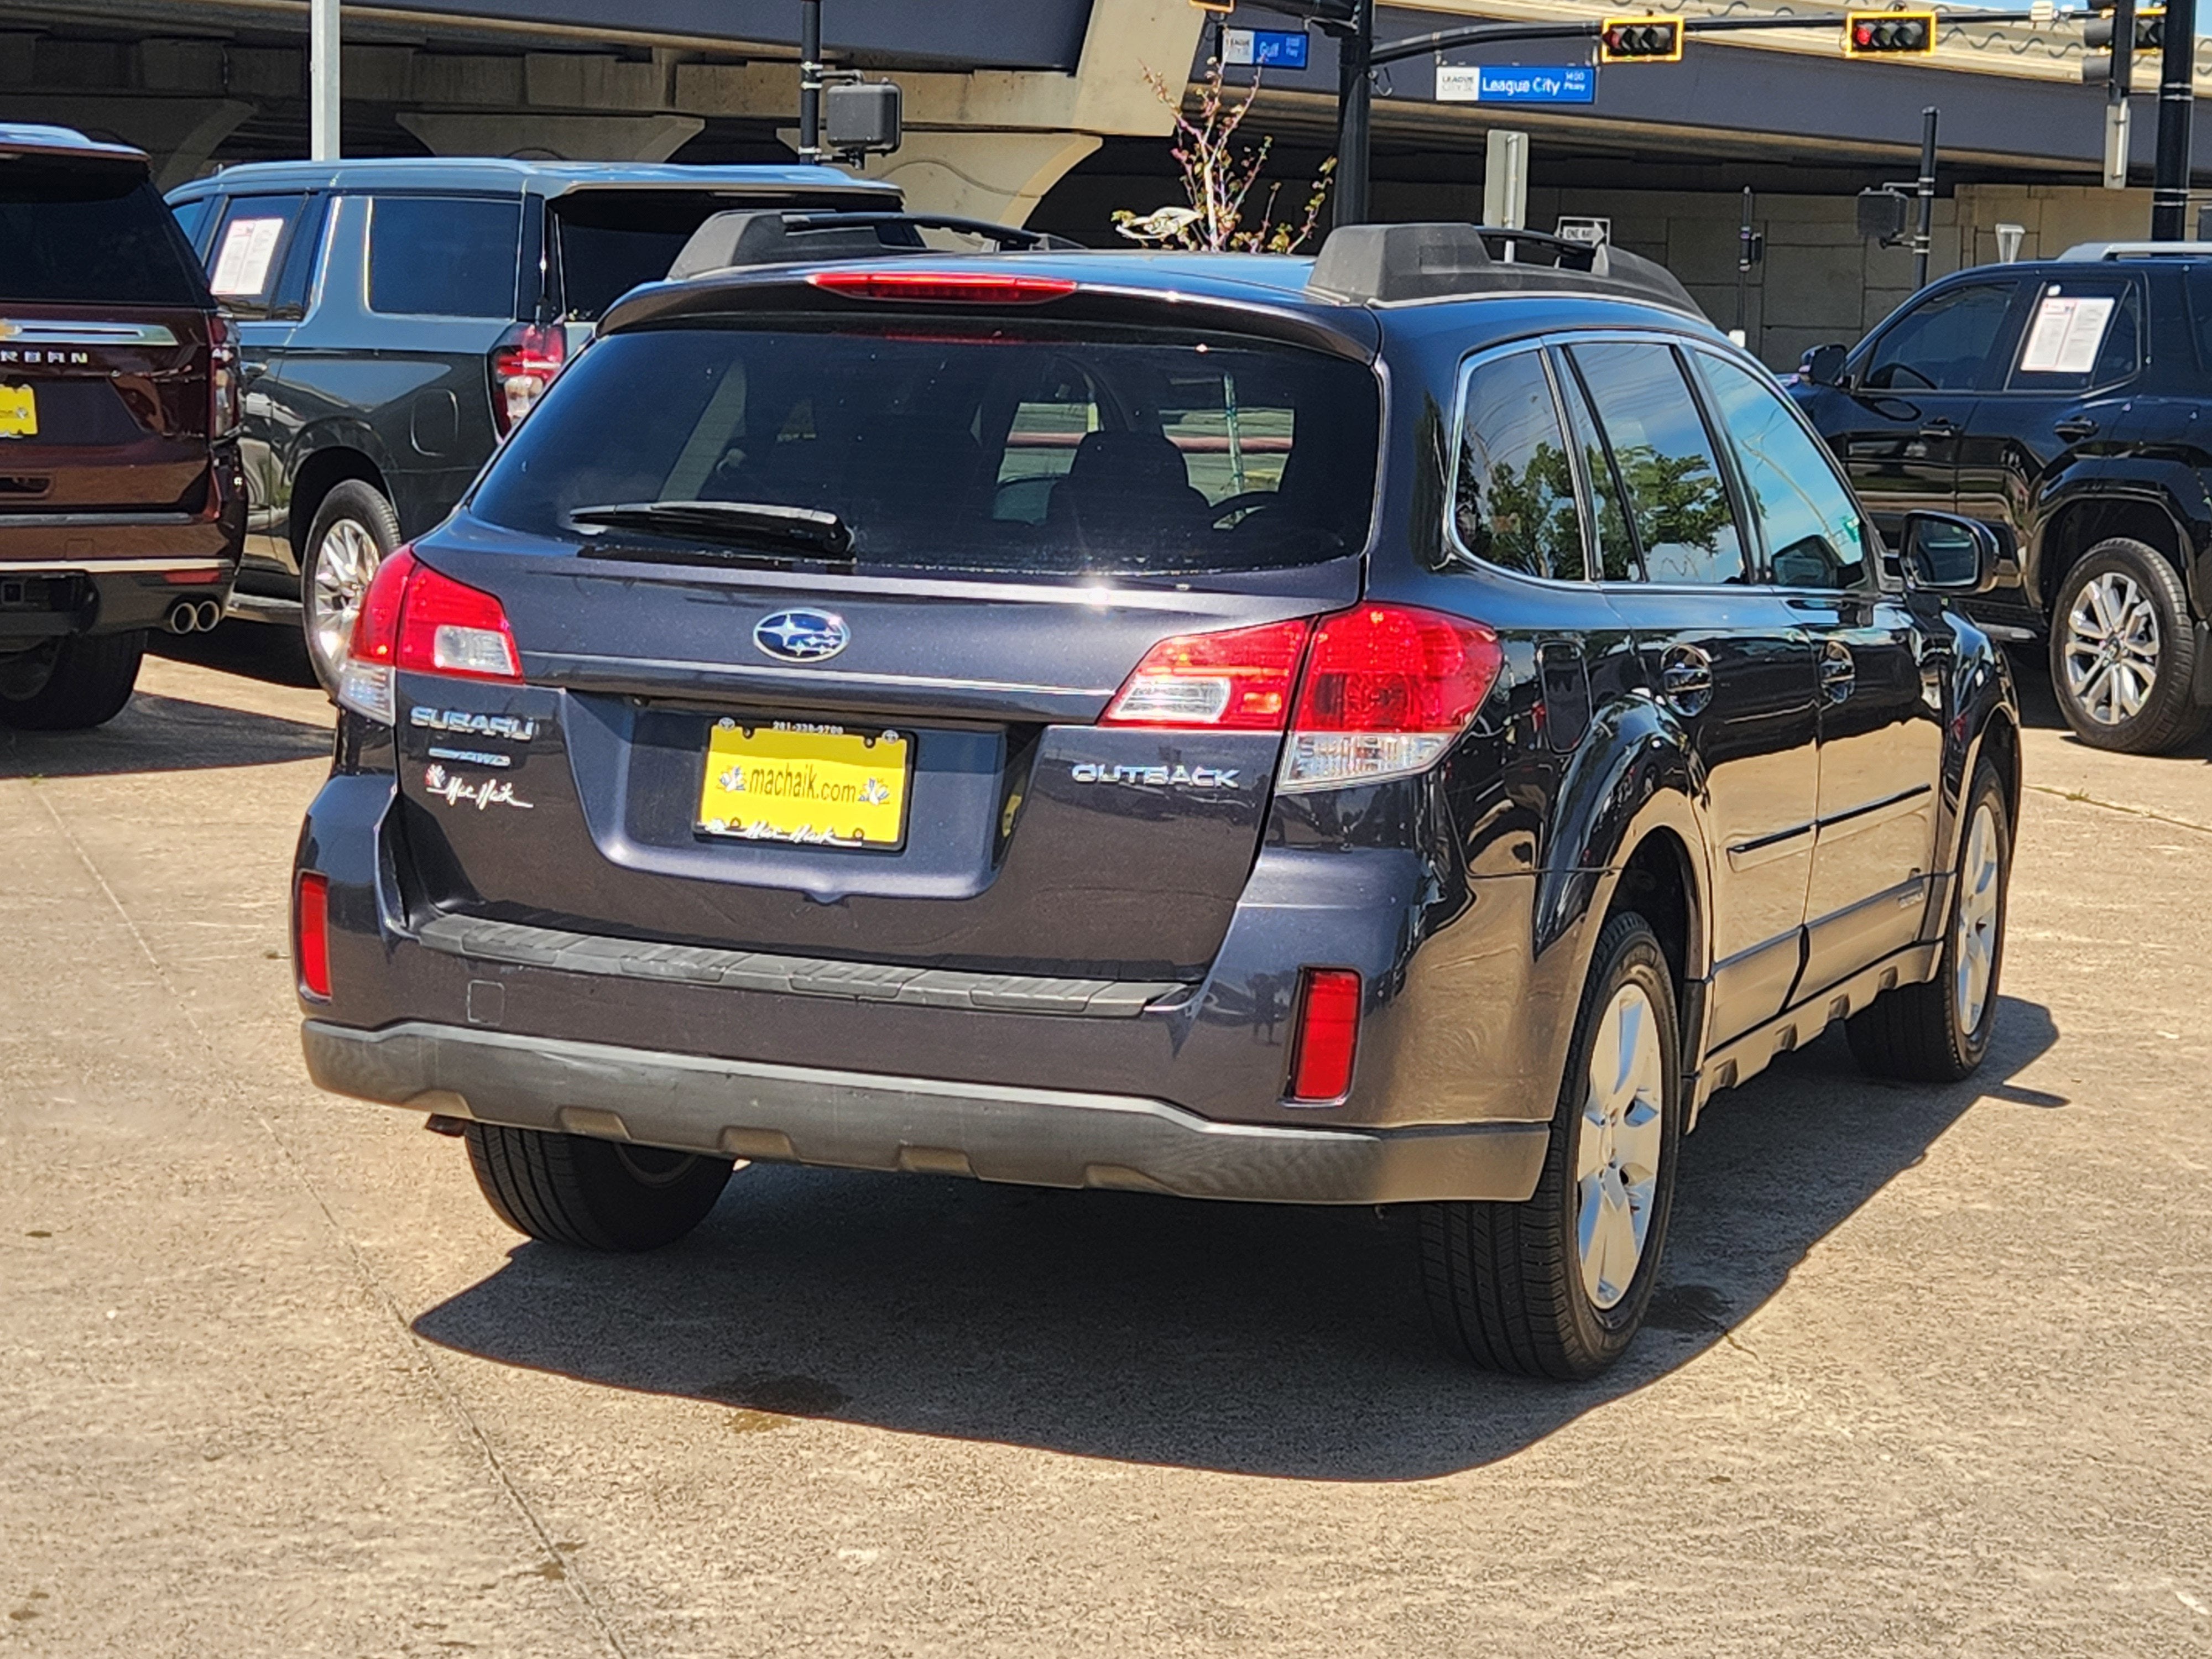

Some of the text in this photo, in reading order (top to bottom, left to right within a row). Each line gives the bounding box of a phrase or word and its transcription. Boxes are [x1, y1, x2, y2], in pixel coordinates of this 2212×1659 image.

[1482, 77, 1561, 96] League City
[410, 706, 534, 740] SUBARU
[749, 763, 857, 804] machaik.com
[1072, 763, 1240, 789] OUTBACK
